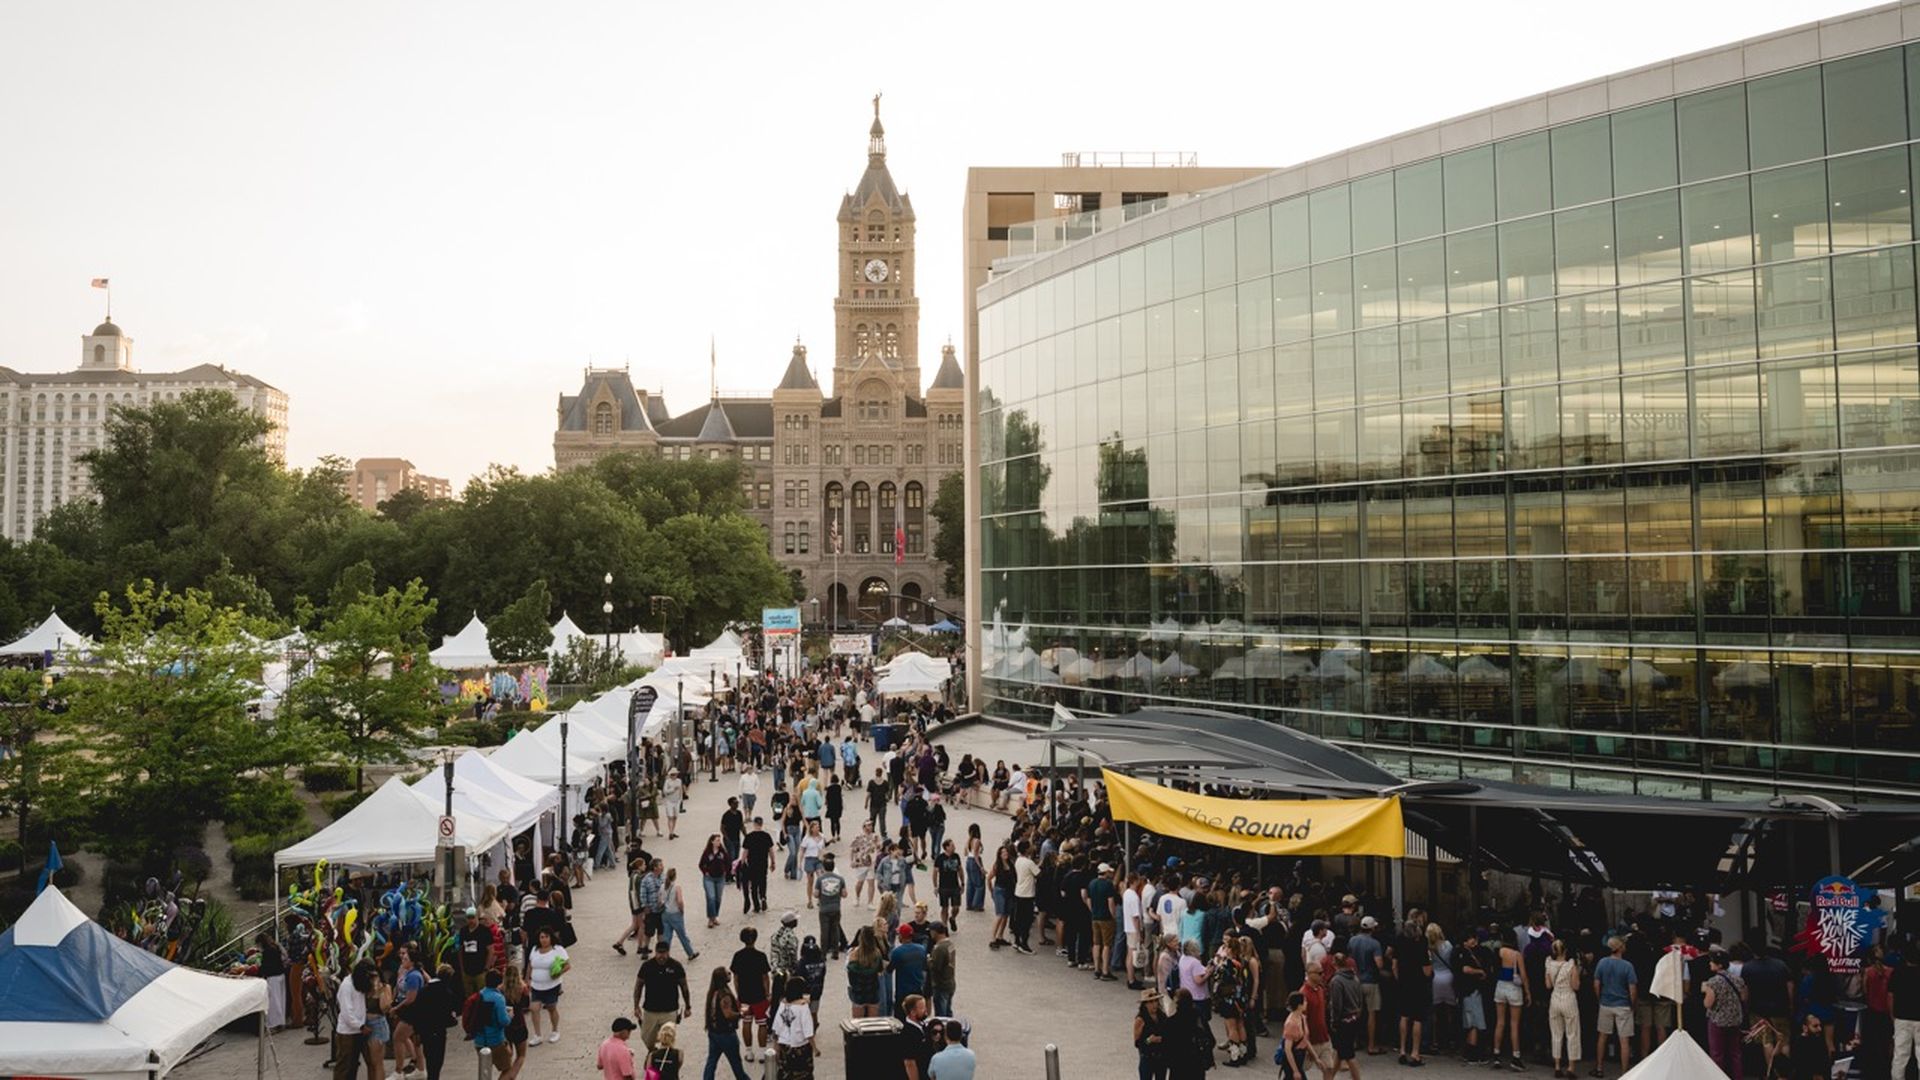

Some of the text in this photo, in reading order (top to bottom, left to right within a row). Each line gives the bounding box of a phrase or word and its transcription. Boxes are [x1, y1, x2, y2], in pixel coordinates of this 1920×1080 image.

[1606, 411, 1711, 431] PSSPORS
[1182, 805, 1312, 841] The Round
[1816, 896, 1860, 907] Red Bull
[1817, 908, 1860, 926] DANCE
[1822, 920, 1864, 939] YOUR
[1820, 934, 1861, 957] STYLE
